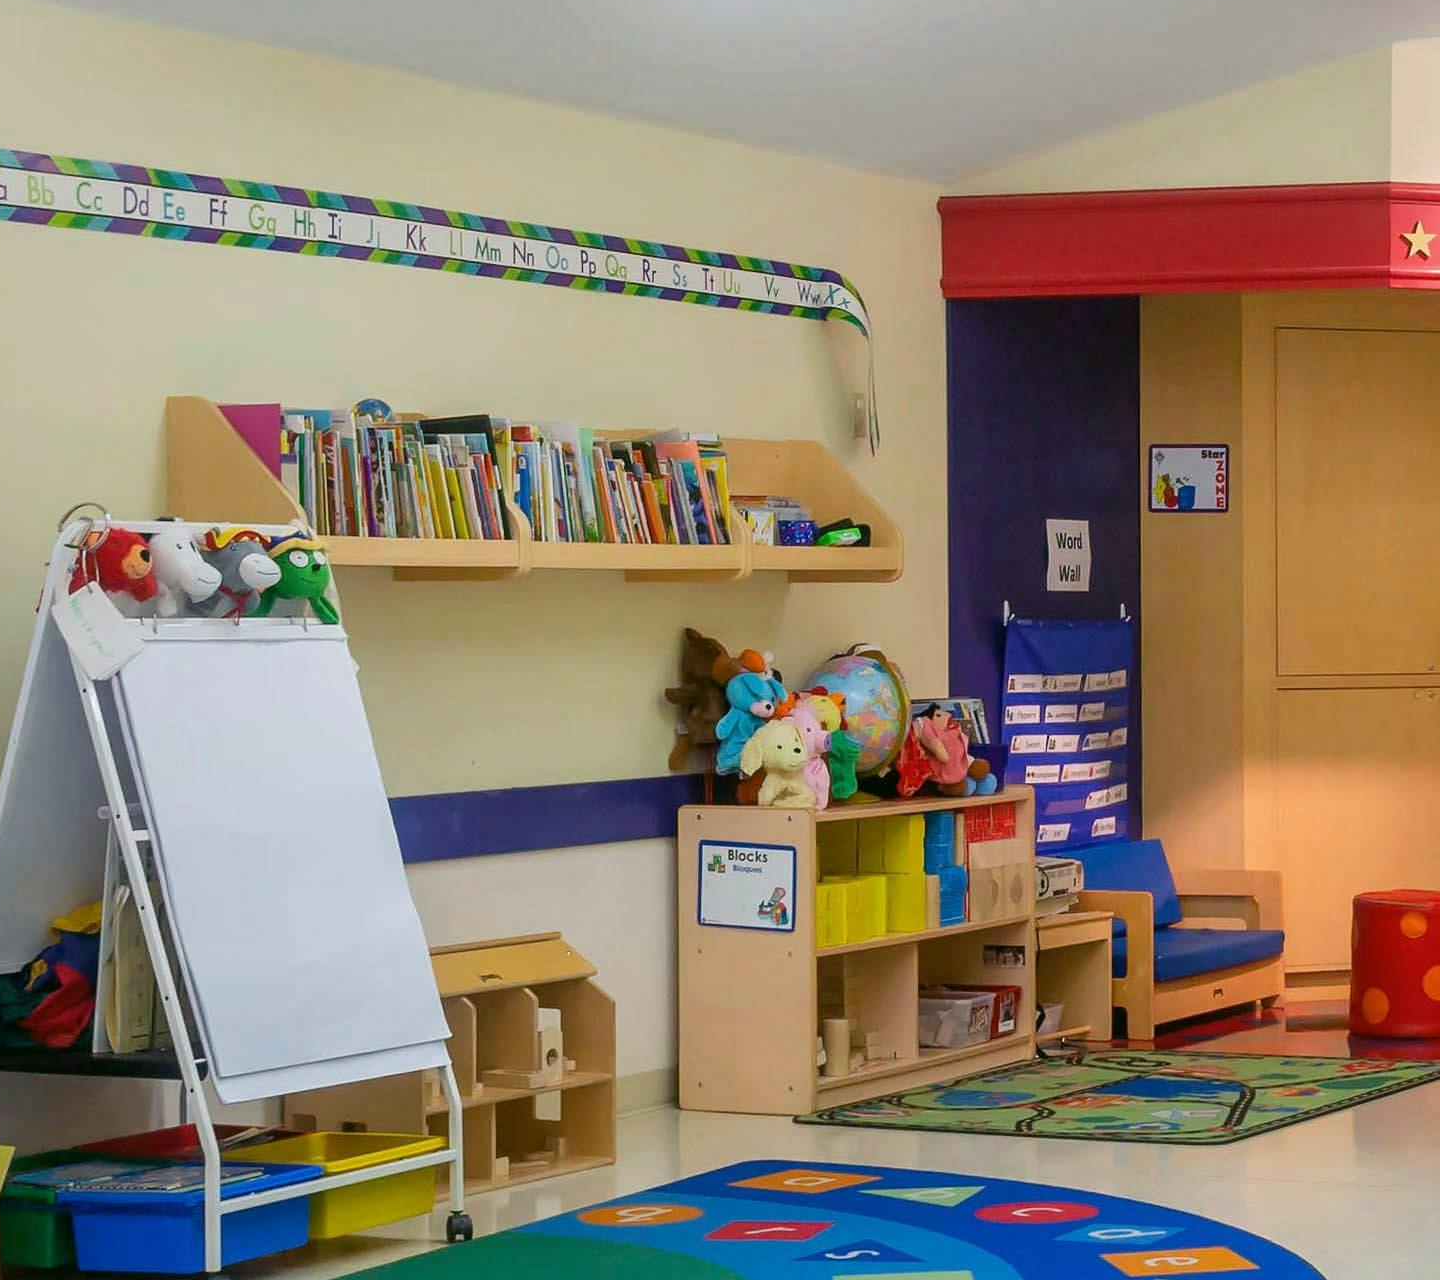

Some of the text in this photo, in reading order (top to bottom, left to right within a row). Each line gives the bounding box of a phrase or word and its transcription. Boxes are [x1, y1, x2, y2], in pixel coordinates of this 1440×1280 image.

[27, 175, 54, 206] Bb
[76, 182, 102, 212] Cc
[123, 187, 149, 217] Dd
[163, 193, 185, 221] Ee
[209, 199, 228, 227] Ff
[249, 205, 276, 237] Gg
[294, 209, 316, 238] Hh
[328, 213, 342, 240] Ii
[366, 219, 380, 249] Jj
[406, 224, 427, 252] Kk
[475, 237, 501, 263] Mm
[513, 243, 535, 267] Nn
[546, 247, 568, 270] Oo
[580, 251, 596, 277] Pp
[605, 254, 627, 280] Qq
[642, 258, 657, 282] Rr
[672, 263, 687, 287] Ss
[702, 268, 714, 292] Tt
[723, 271, 740, 295] Uu
[764, 276, 779, 298] Vv
[797, 281, 820, 304] Ww
[1201, 450, 1225, 459] Star
[1215, 460, 1225, 508] ZONE
[1055, 531, 1083, 553] Word
[1058, 564, 1081, 584] Wall
[728, 850, 768, 863] Blocks
